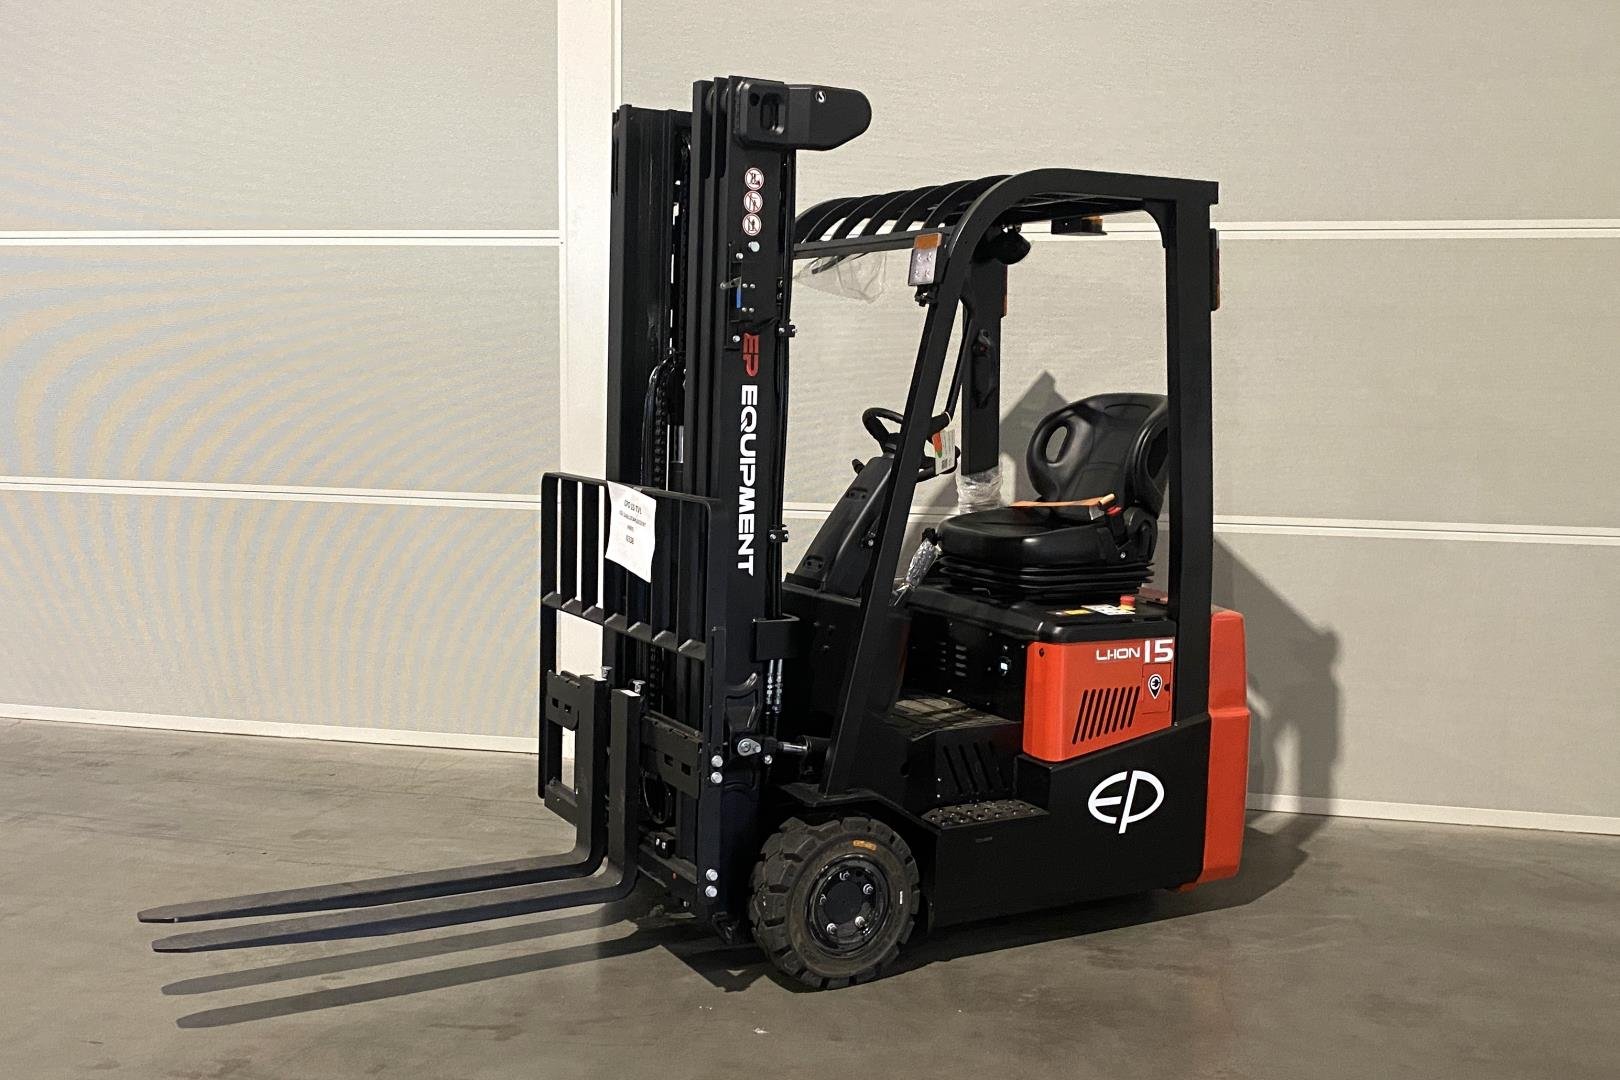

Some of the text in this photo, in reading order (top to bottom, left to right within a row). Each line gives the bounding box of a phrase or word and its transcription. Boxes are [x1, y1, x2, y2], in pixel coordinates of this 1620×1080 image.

[737, 384, 758, 577] EQUIPMENT
[1143, 638, 1174, 663] 15
[1087, 769, 1165, 834] EP
